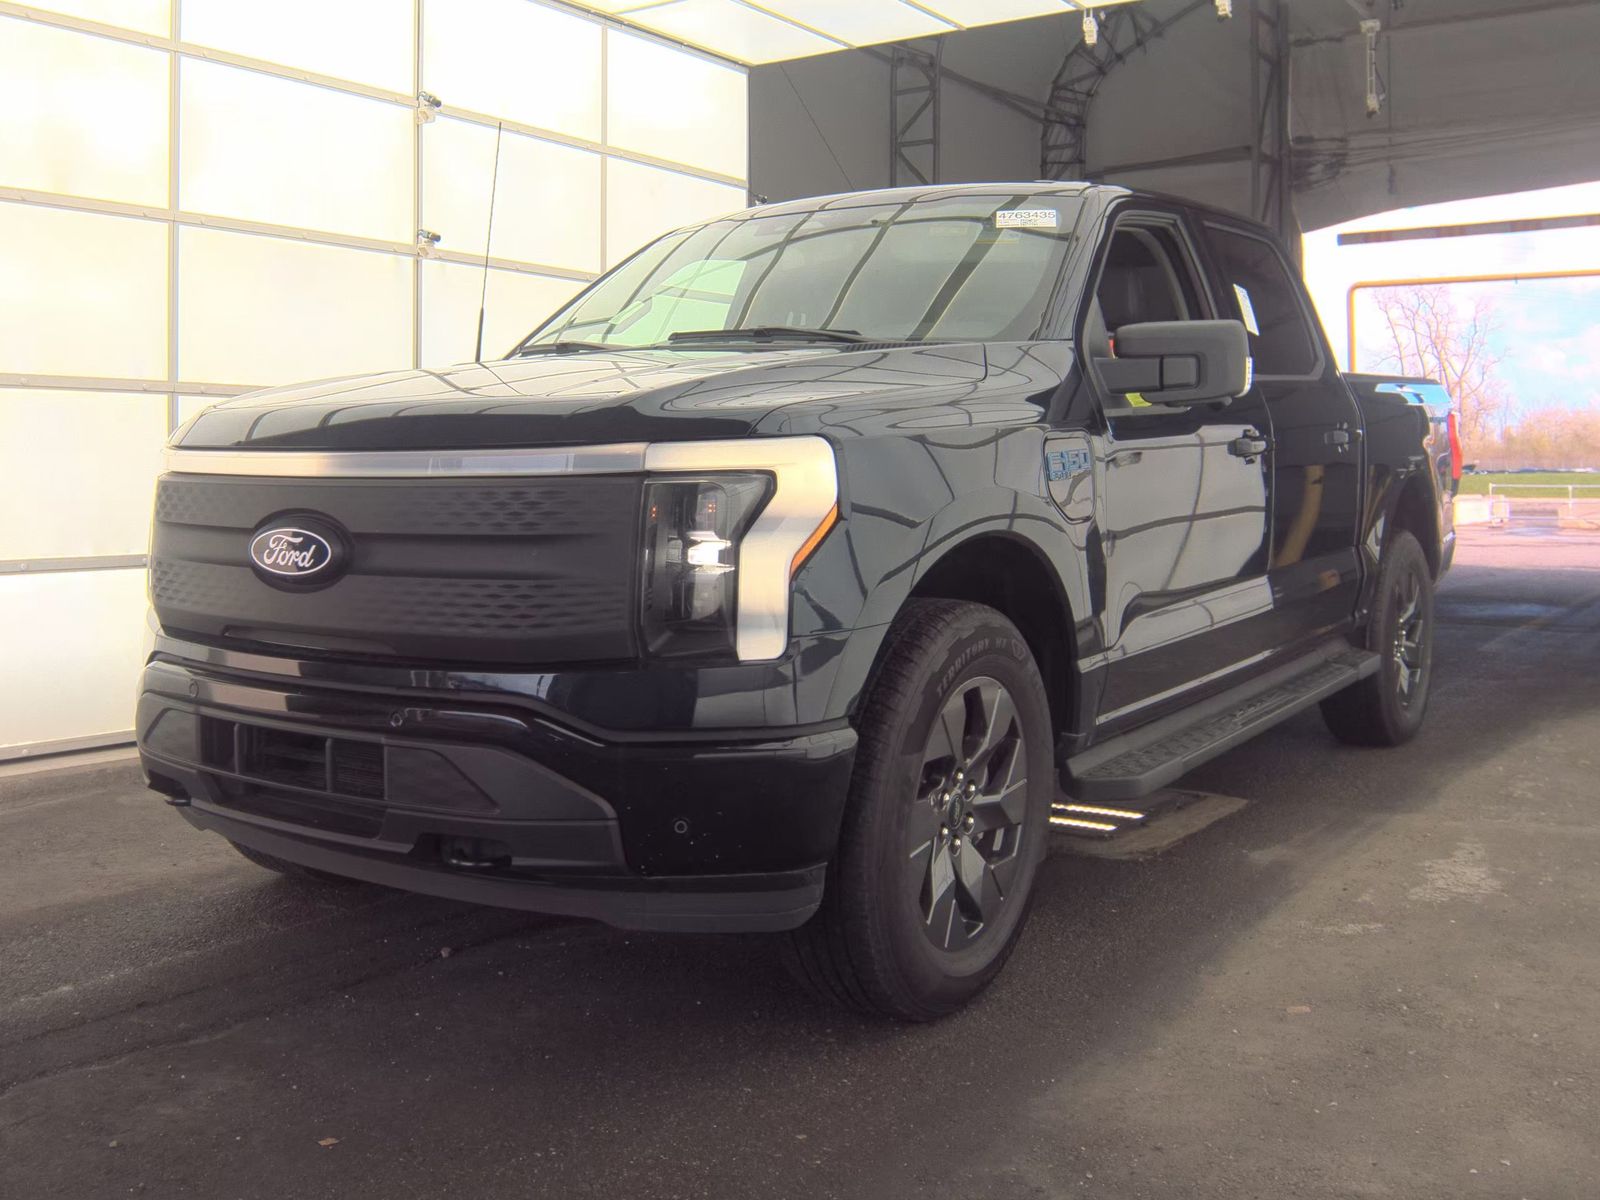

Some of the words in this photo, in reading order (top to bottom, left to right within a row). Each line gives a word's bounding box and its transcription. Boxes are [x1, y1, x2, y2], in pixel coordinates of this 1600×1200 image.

[998, 211, 1056, 219] 4763435
[263, 534, 317, 568] Ford
[936, 637, 990, 697] TERRITORY
